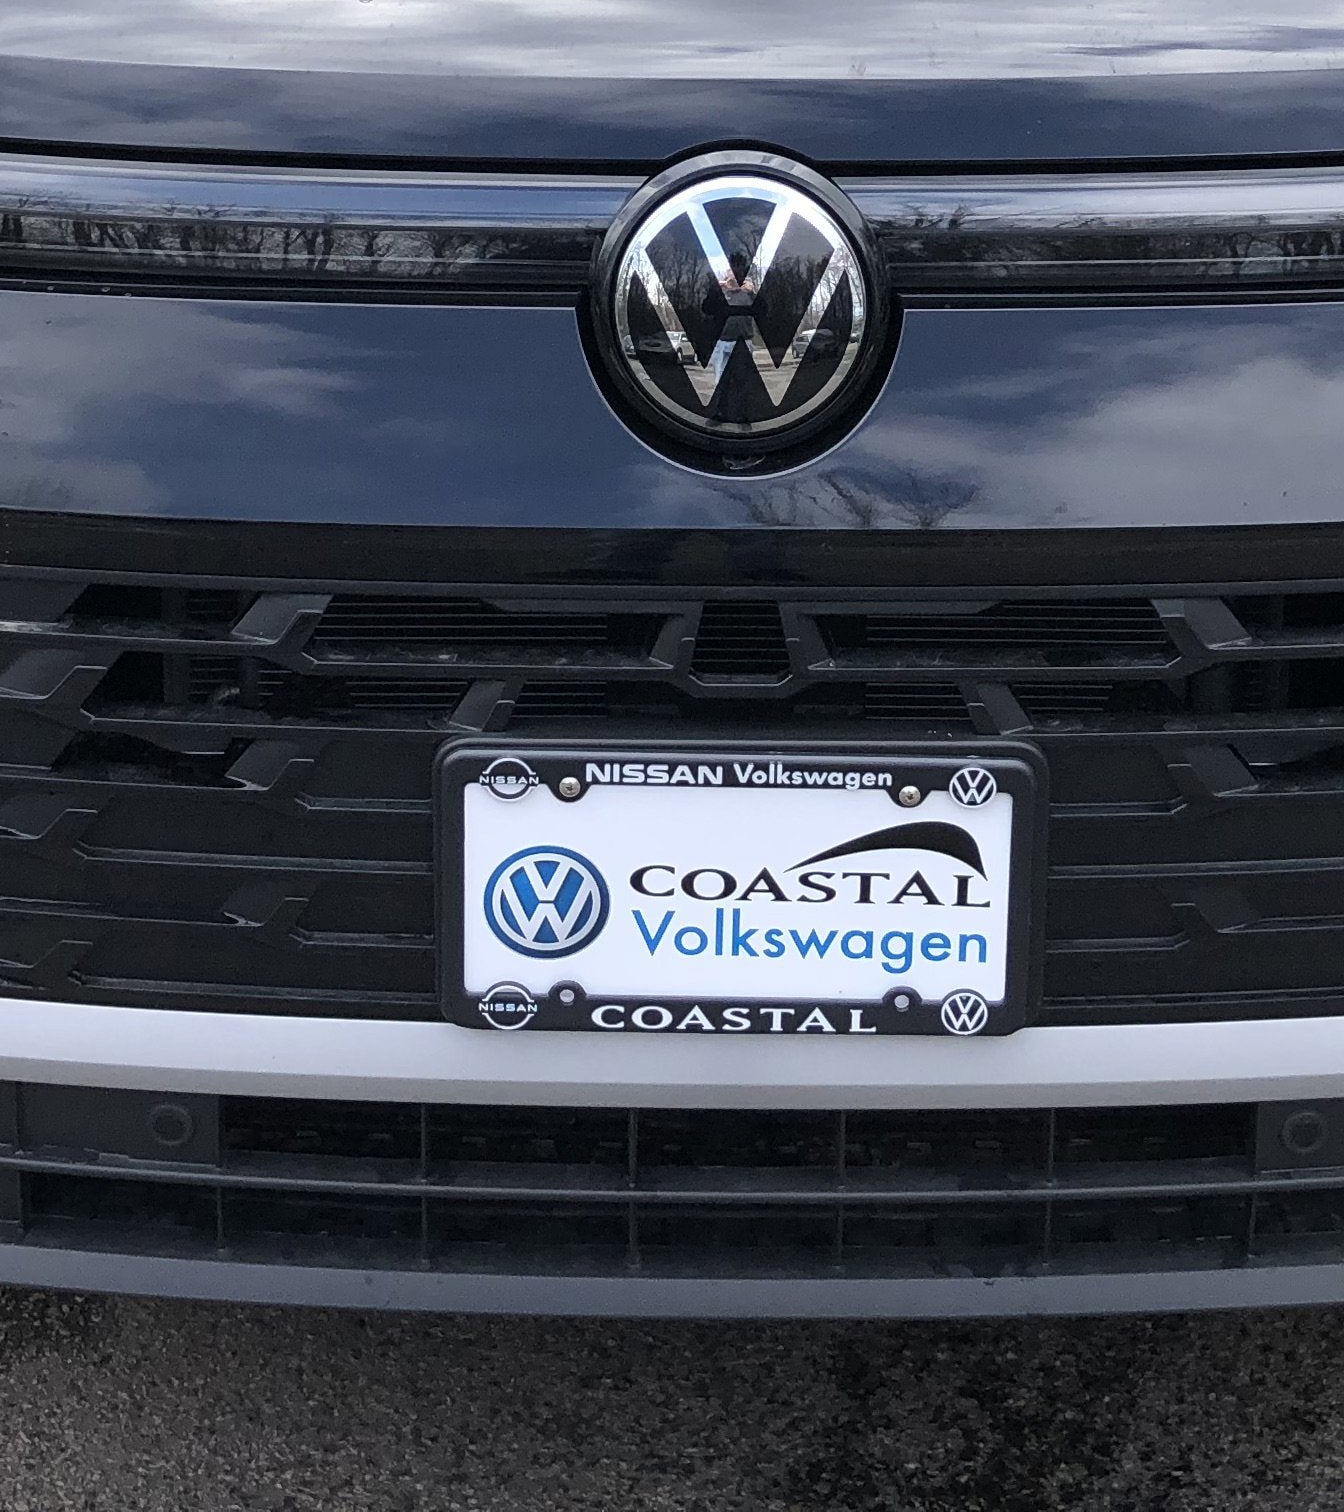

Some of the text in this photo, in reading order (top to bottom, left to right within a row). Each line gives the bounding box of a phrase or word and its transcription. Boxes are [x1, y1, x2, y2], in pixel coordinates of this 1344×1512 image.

[620, 184, 862, 410] VW
[479, 775, 539, 785] NISSAN
[585, 762, 893, 790] NISSAN Volkswagen
[629, 865, 991, 908] COASTAL
[631, 907, 988, 974] Volkswagen
[478, 1002, 538, 1013] NISSAN
[591, 1004, 877, 1033] COASTAL
